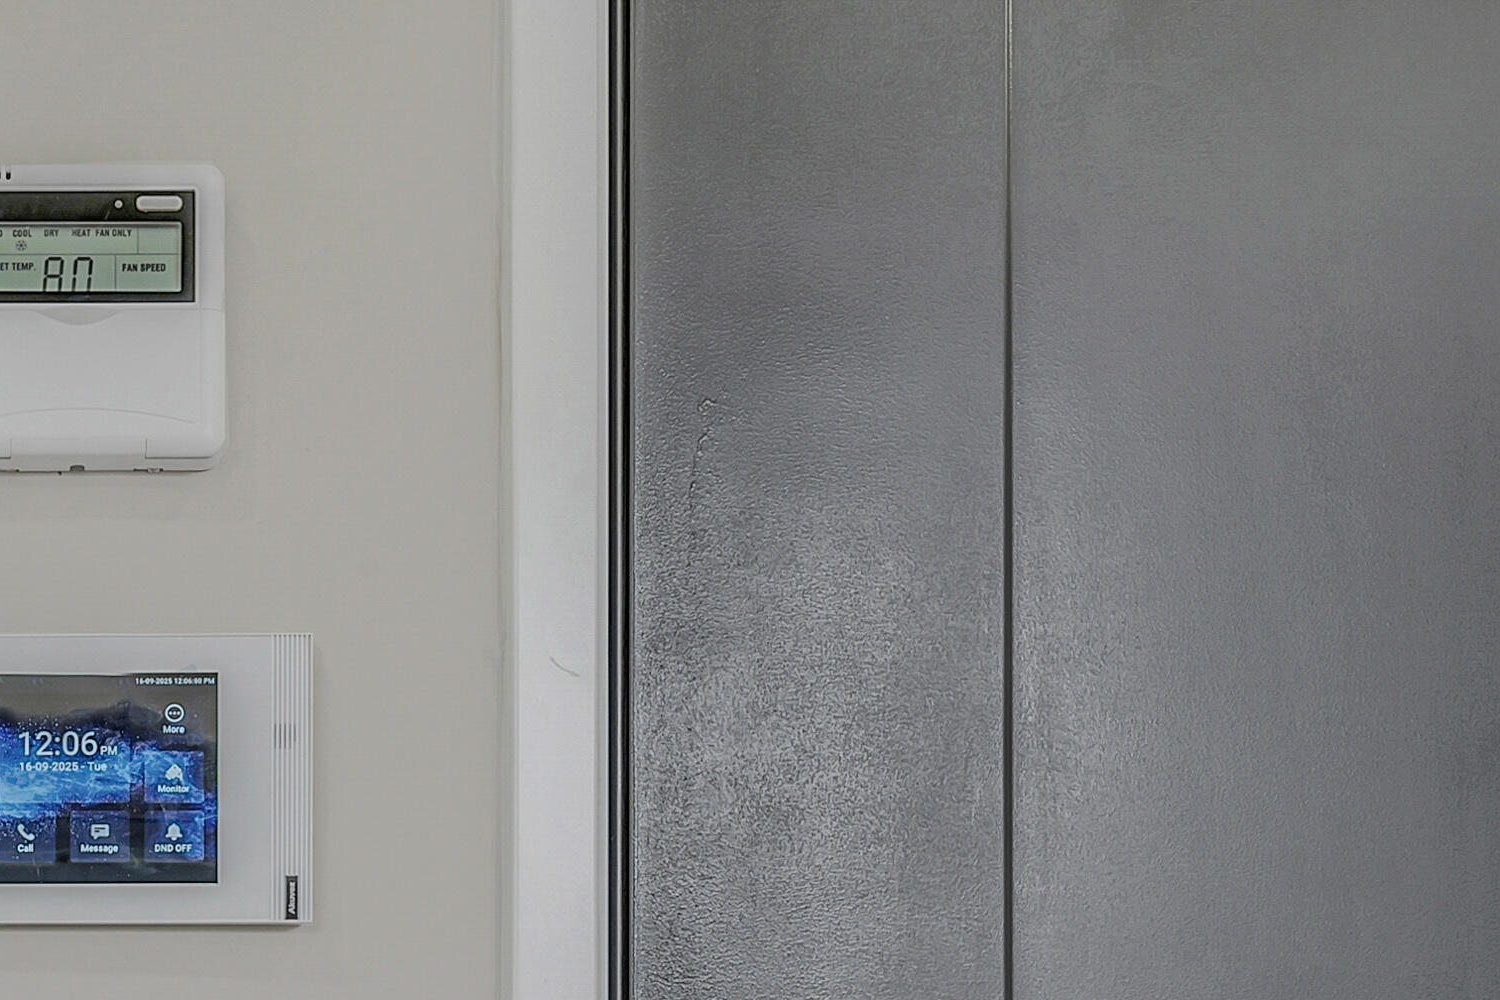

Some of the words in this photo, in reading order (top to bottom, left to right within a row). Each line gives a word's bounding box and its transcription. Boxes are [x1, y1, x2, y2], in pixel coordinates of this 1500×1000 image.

[12, 229, 32, 238] COOL
[44, 229, 59, 237] DRY
[72, 229, 90, 237] HEAT
[96, 229, 110, 237] FAN
[112, 229, 132, 237] ONLY
[122, 263, 137, 272] FAN
[140, 263, 166, 272] SPEED
[204, 677, 215, 685] PM
[162, 725, 185, 734] More
[18, 730, 98, 756] 12:06
[100, 746, 118, 756] PM
[20, 762, 78, 772] 16-09-2025
[87, 762, 108, 772] Tue
[157, 784, 190, 793] Monitor
[17, 844, 34, 853] Call
[80, 844, 118, 855] Message
[154, 844, 173, 852] DND
[176, 844, 192, 852] OFF
